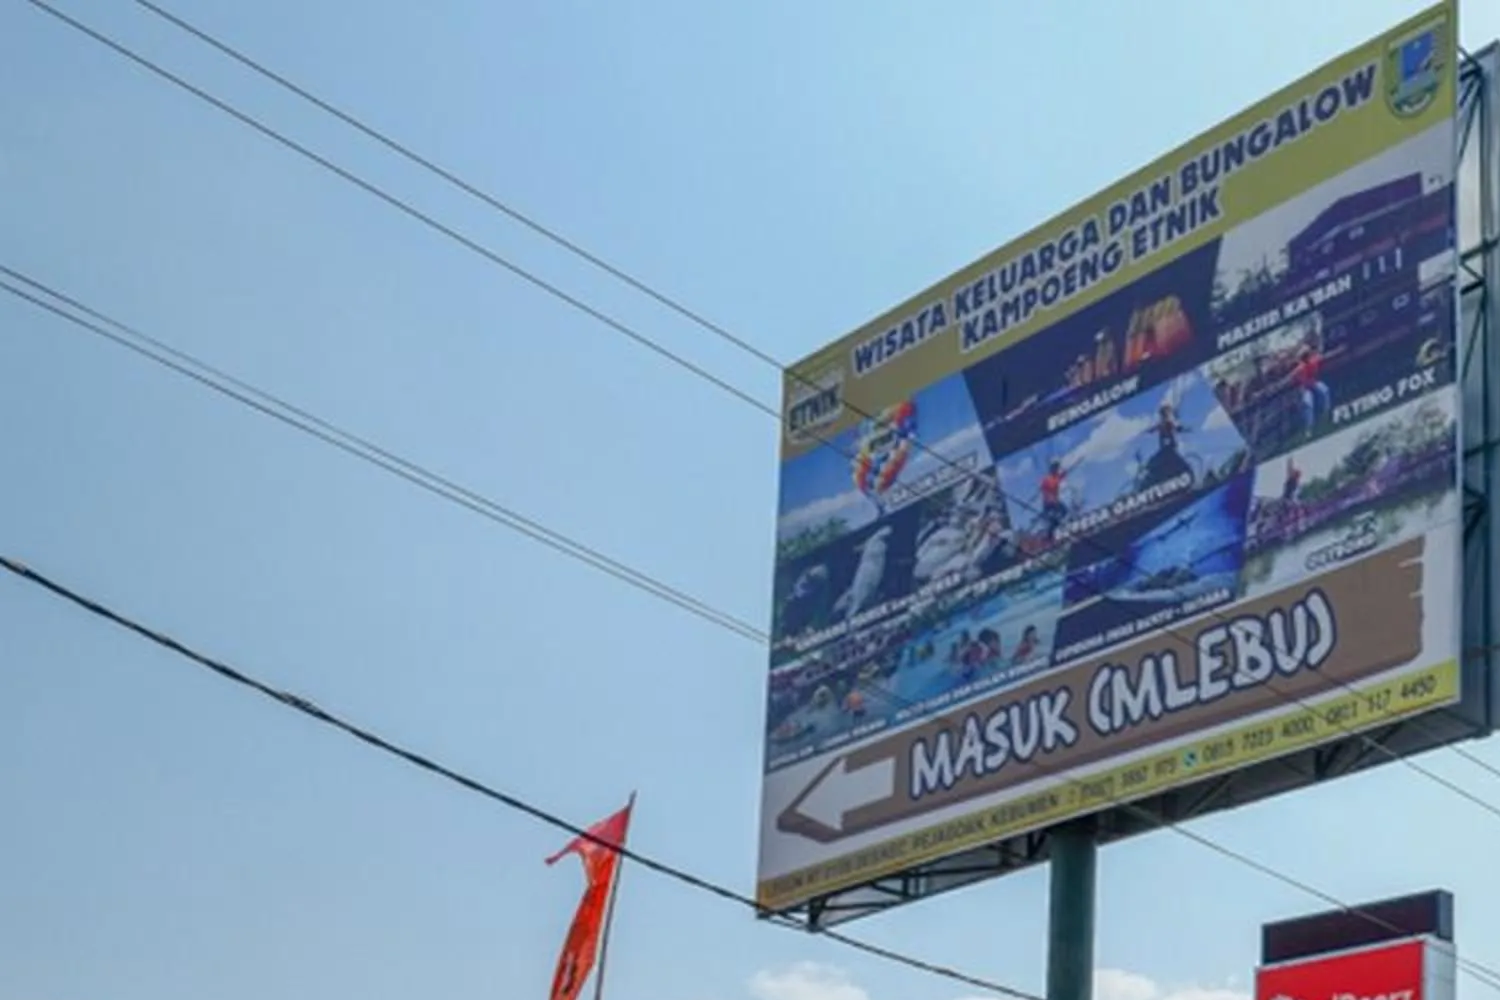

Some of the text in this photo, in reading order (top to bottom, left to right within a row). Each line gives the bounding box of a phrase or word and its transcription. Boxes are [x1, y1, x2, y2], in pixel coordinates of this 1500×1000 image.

[854, 63, 1378, 375] WISATA KELUARGA DAN BUNGALOW
[962, 186, 1221, 350] KAMPOENG ETNIK
[787, 384, 841, 433] ETNIK
[1332, 367, 1437, 424] FLYING FOX
[908, 684, 1083, 799] MASUK
[1087, 586, 1337, 735] (MLEBU)
